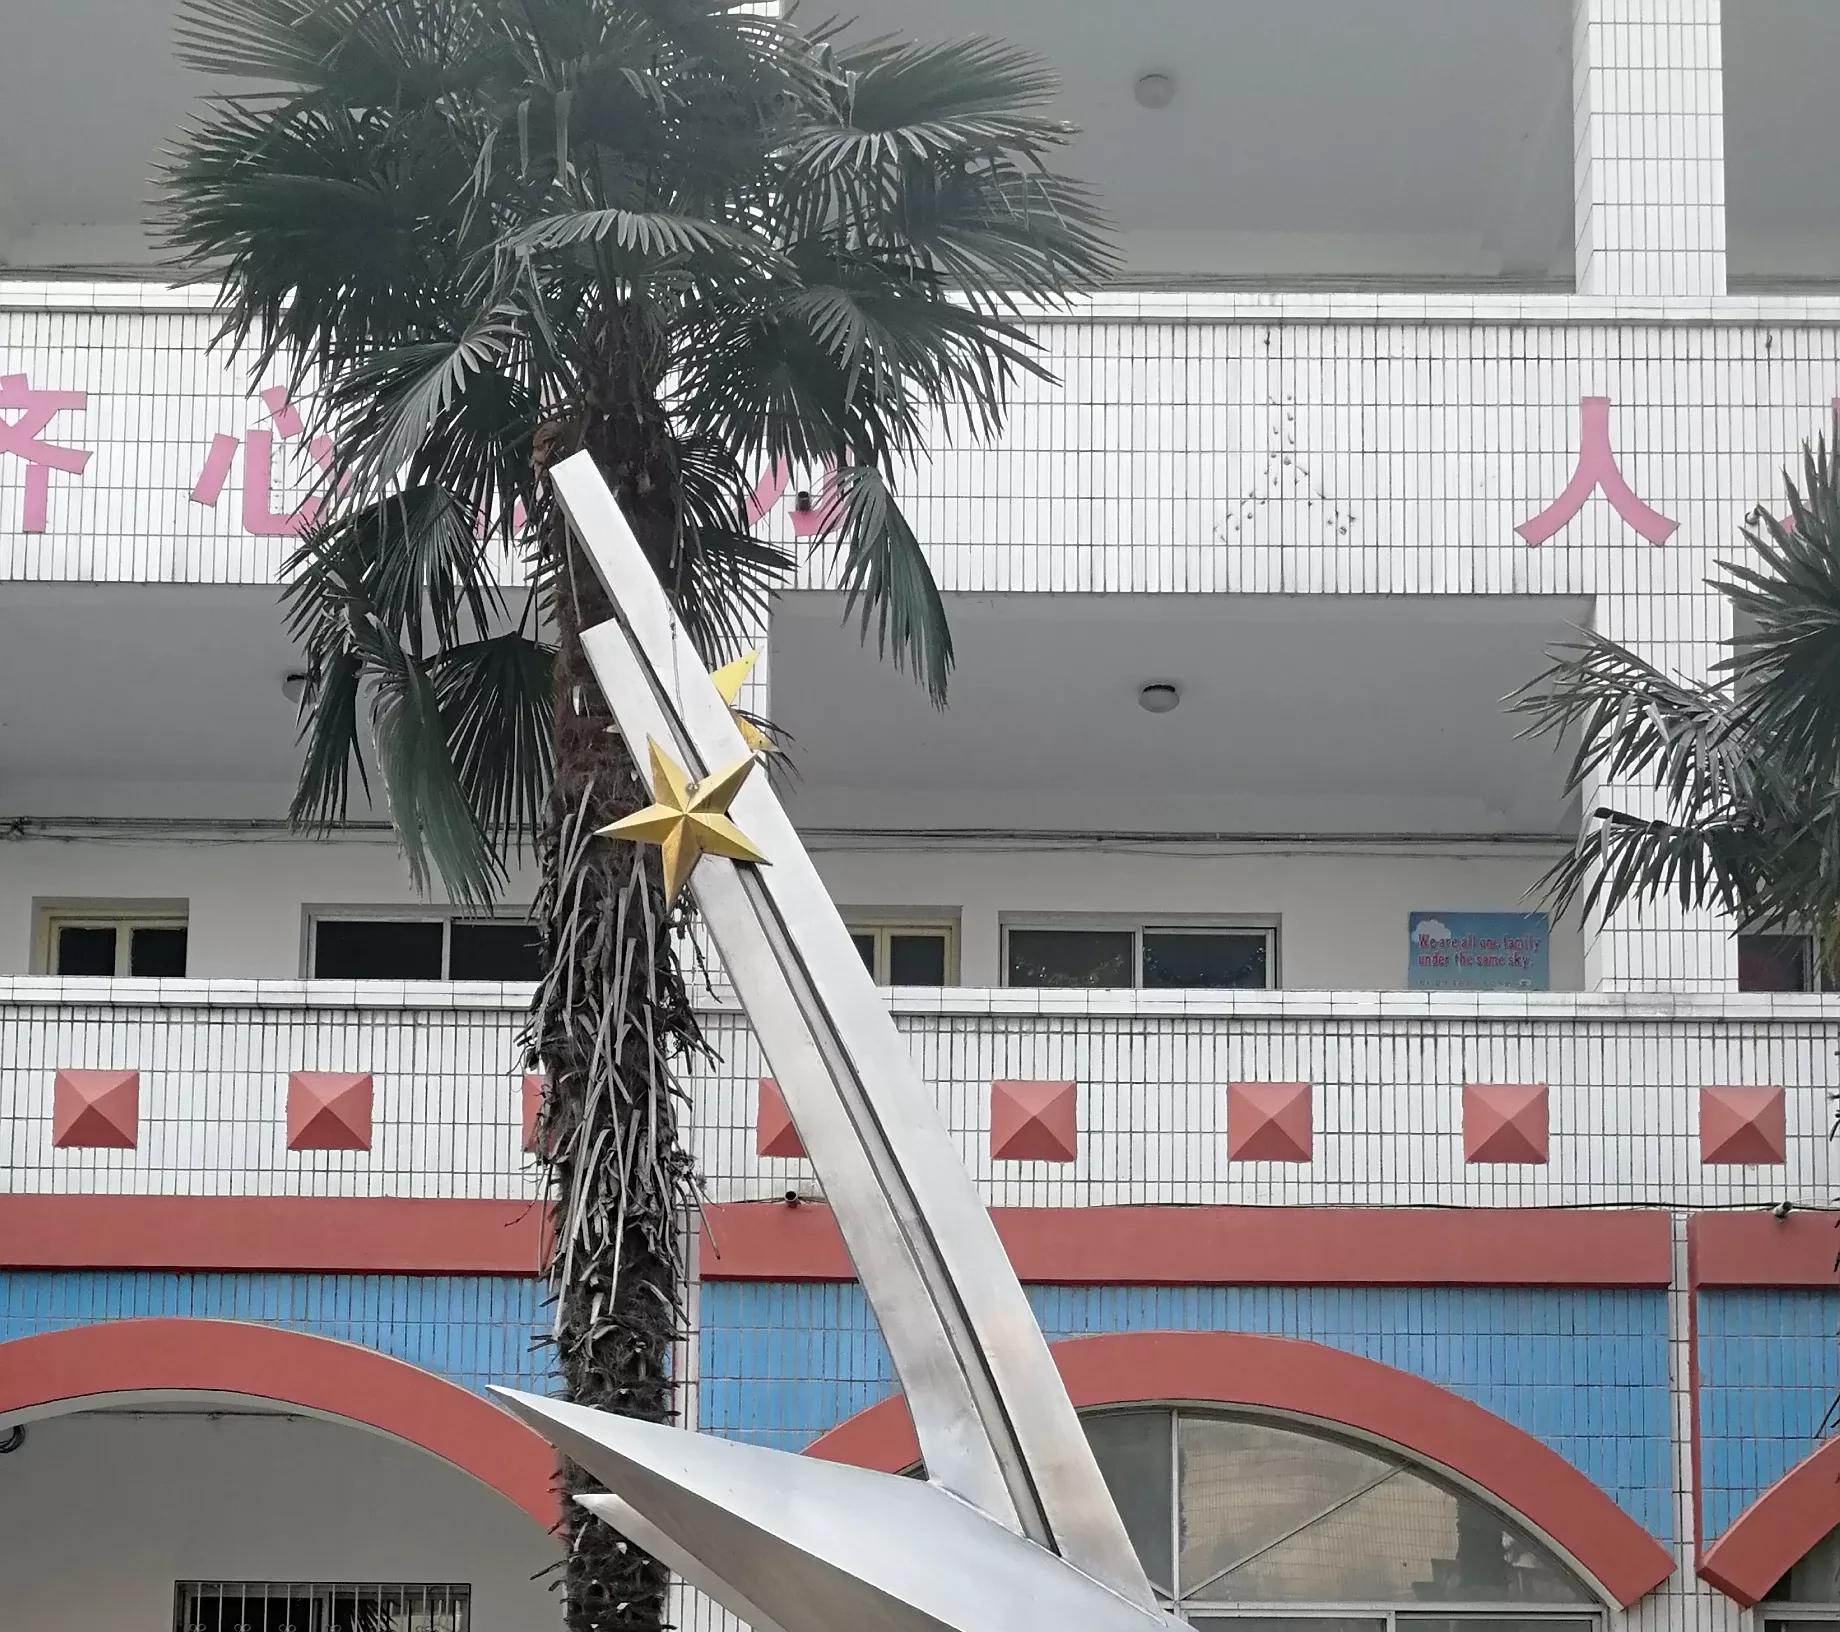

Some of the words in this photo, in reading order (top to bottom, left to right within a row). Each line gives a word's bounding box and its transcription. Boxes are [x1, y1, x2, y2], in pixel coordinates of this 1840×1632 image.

[1418, 933, 1437, 949] We
[1440, 938, 1457, 949] are
[1461, 934, 1476, 949] all
[1503, 934, 1541, 951] family
[1418, 952, 1449, 967] under
[1455, 952, 1473, 967] the
[1476, 955, 1506, 966] same
